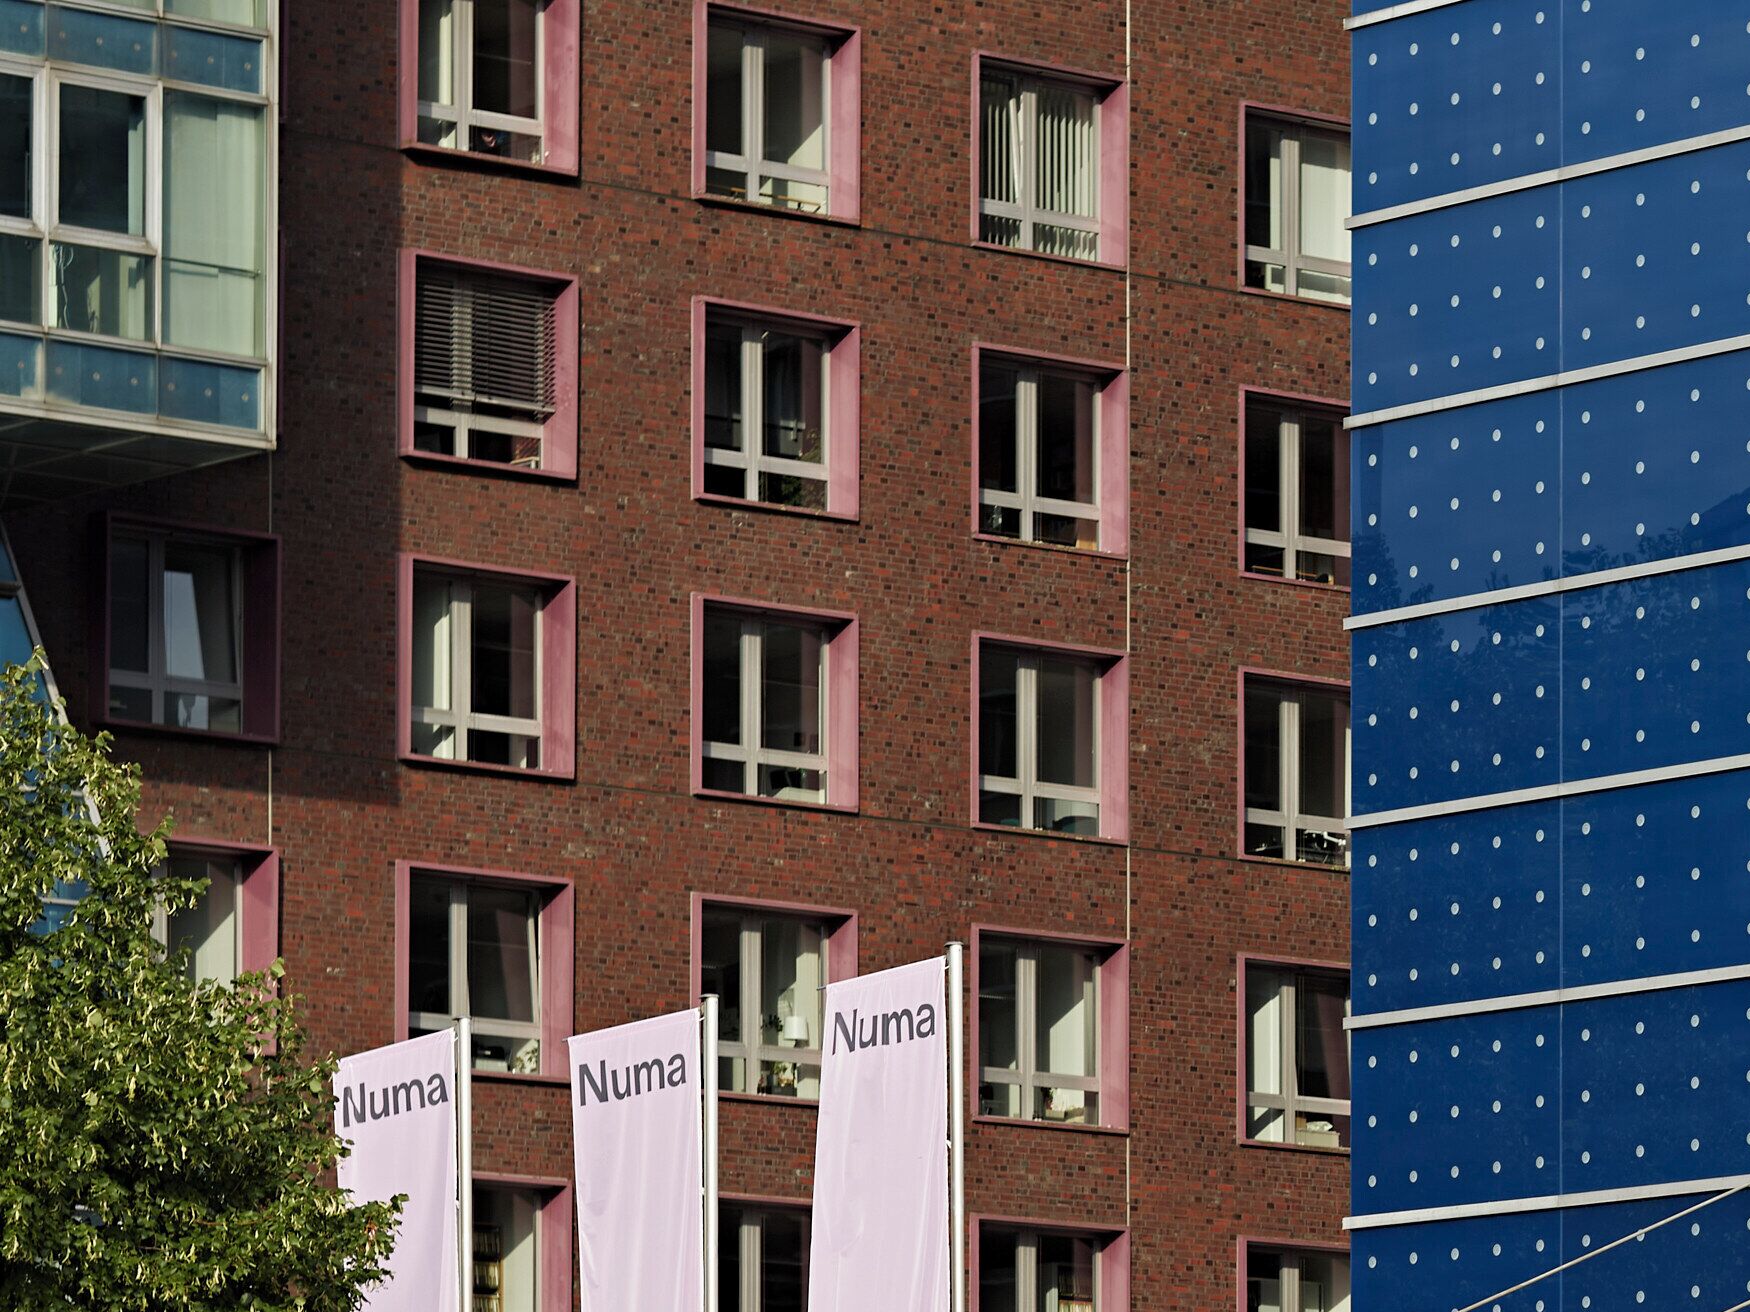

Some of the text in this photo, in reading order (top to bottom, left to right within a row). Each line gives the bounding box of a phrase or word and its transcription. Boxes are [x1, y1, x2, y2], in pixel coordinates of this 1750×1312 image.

[832, 1003, 936, 1056] Numa
[342, 1073, 449, 1128] Numa
[579, 1053, 687, 1106] Numa
